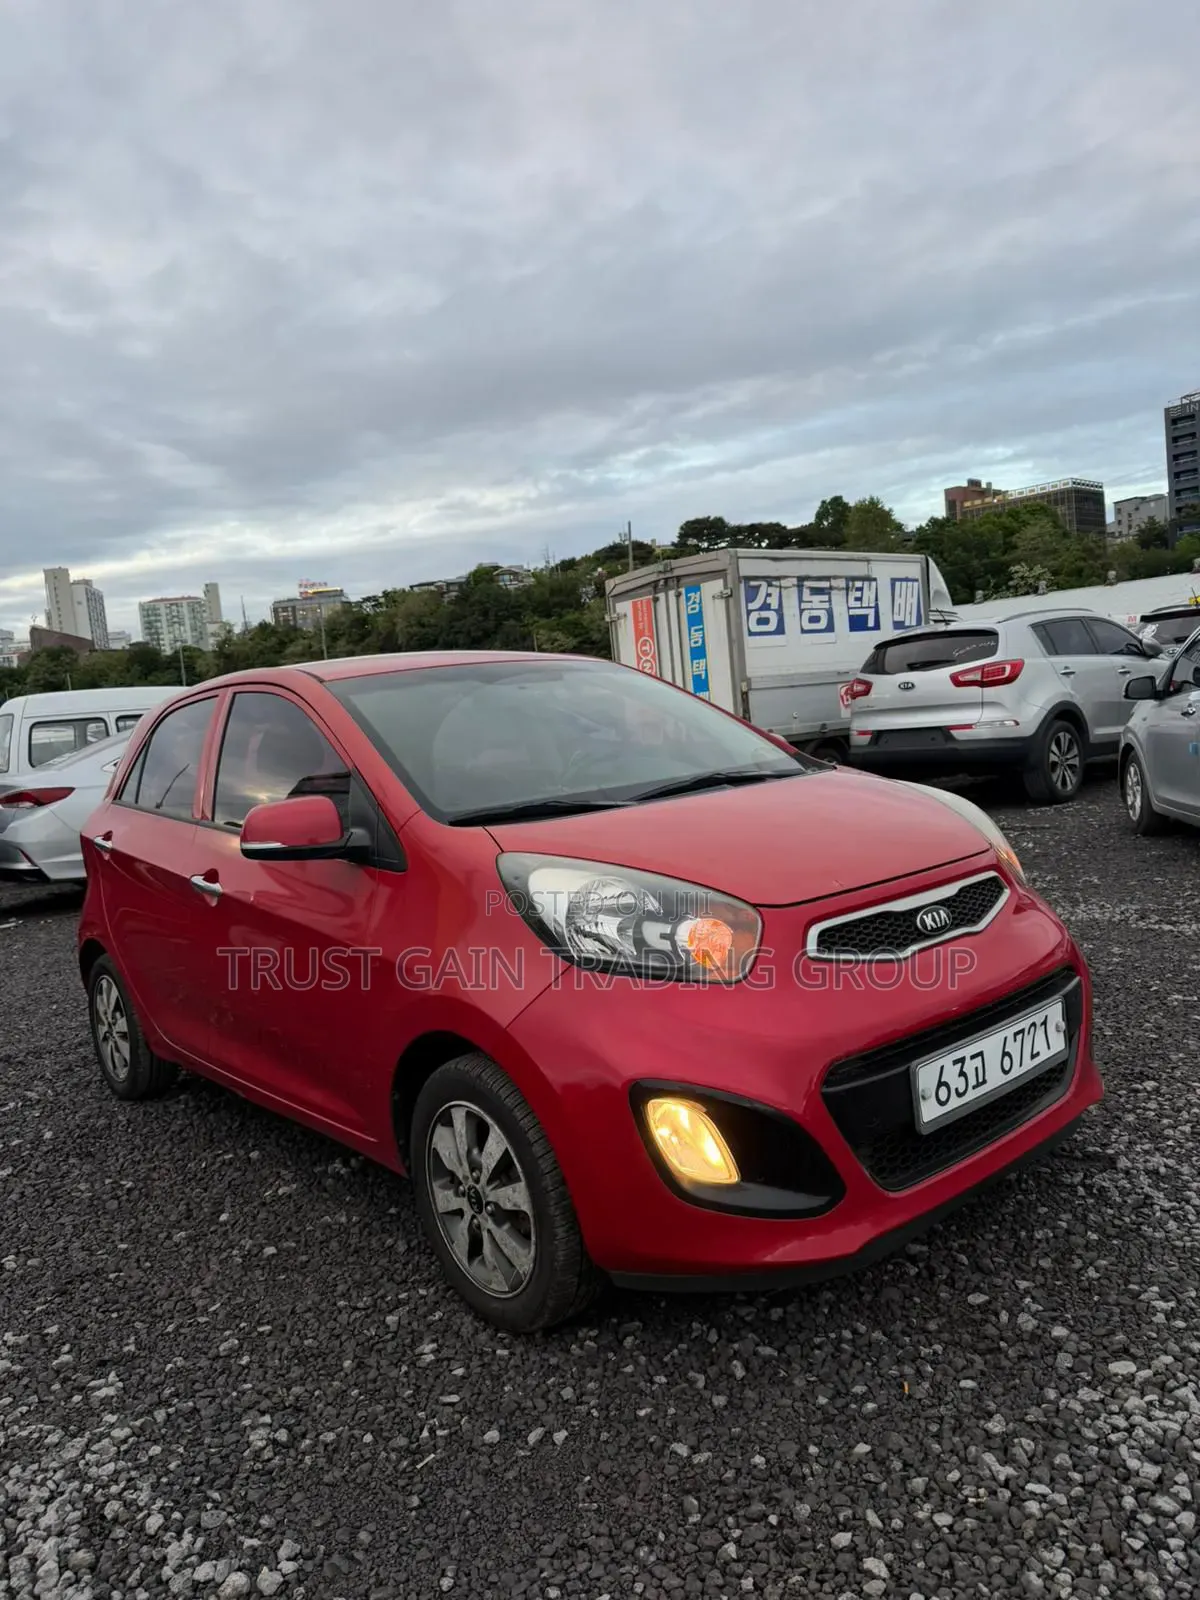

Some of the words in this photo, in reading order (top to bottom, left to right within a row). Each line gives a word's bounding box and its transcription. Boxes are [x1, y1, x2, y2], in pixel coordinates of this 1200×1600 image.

[747, 580, 919, 632] 경동택배
[687, 591, 709, 699] 경동택
[899, 682, 914, 690] KIA
[922, 909, 950, 930] KIA
[934, 1050, 987, 1106] 63고
[1000, 1014, 1051, 1075] 6721
